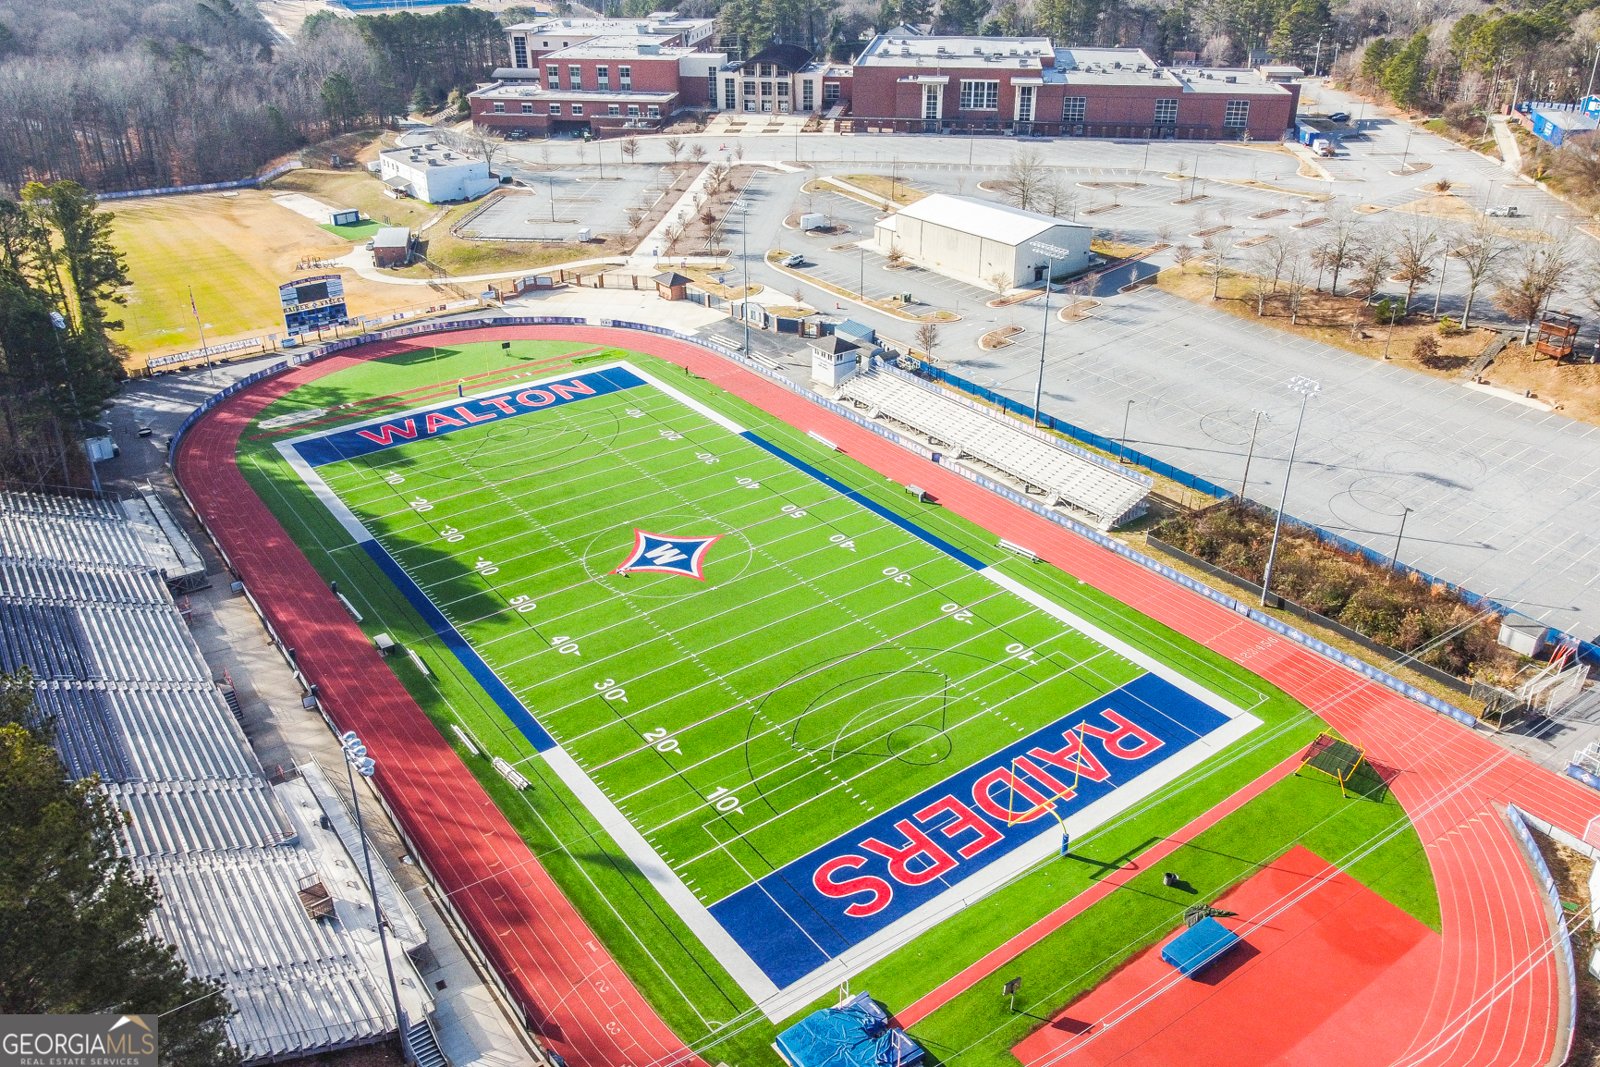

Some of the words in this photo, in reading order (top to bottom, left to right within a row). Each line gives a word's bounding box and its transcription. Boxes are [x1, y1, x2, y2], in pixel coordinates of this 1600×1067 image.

[356, 380, 597, 446] WALTON
[697, 453, 720, 465] 30
[384, 473, 406, 485] 10
[737, 477, 761, 489] 40
[409, 498, 434, 512] 20
[781, 504, 807, 519] 50
[440, 527, 465, 543] 30
[829, 534, 856, 548] 40
[644, 542, 689, 566] W
[475, 561, 499, 576] 40
[882, 566, 911, 583] 30
[509, 594, 537, 613] 50
[940, 602, 974, 622] 20
[551, 635, 579, 654] 40
[1005, 642, 1035, 661] 10
[594, 678, 626, 700] 30
[643, 727, 679, 752] 20
[706, 786, 739, 811] 10
[812, 707, 1166, 918] RAIDERS
[595, 979, 609, 993] 2
[606, 1021, 620, 1035] 3
